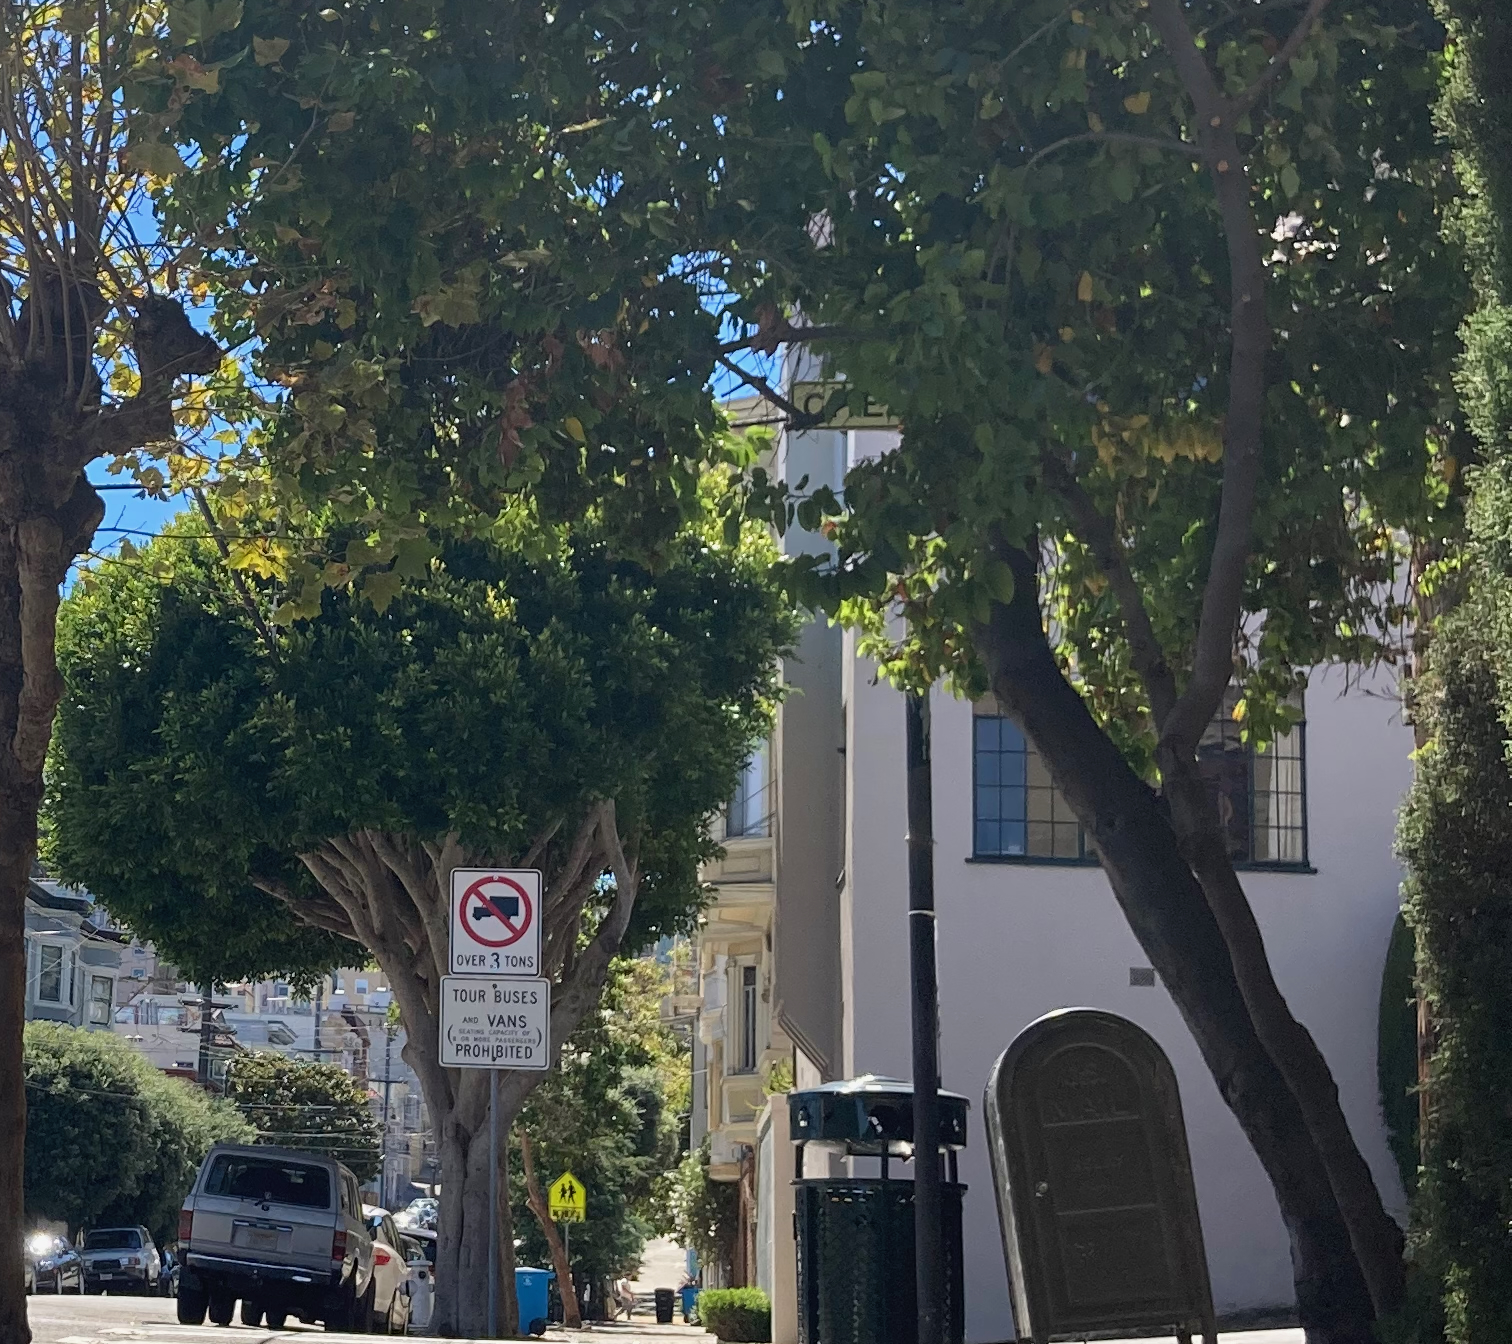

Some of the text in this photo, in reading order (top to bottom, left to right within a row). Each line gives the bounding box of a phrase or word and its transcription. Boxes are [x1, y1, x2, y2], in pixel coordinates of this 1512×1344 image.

[457, 953, 534, 970] OVER 3 TONS
[453, 989, 538, 1004] TOUR BUSES
[462, 1014, 527, 1029] AND VANS
[455, 1044, 533, 1059] PROHIBITED
